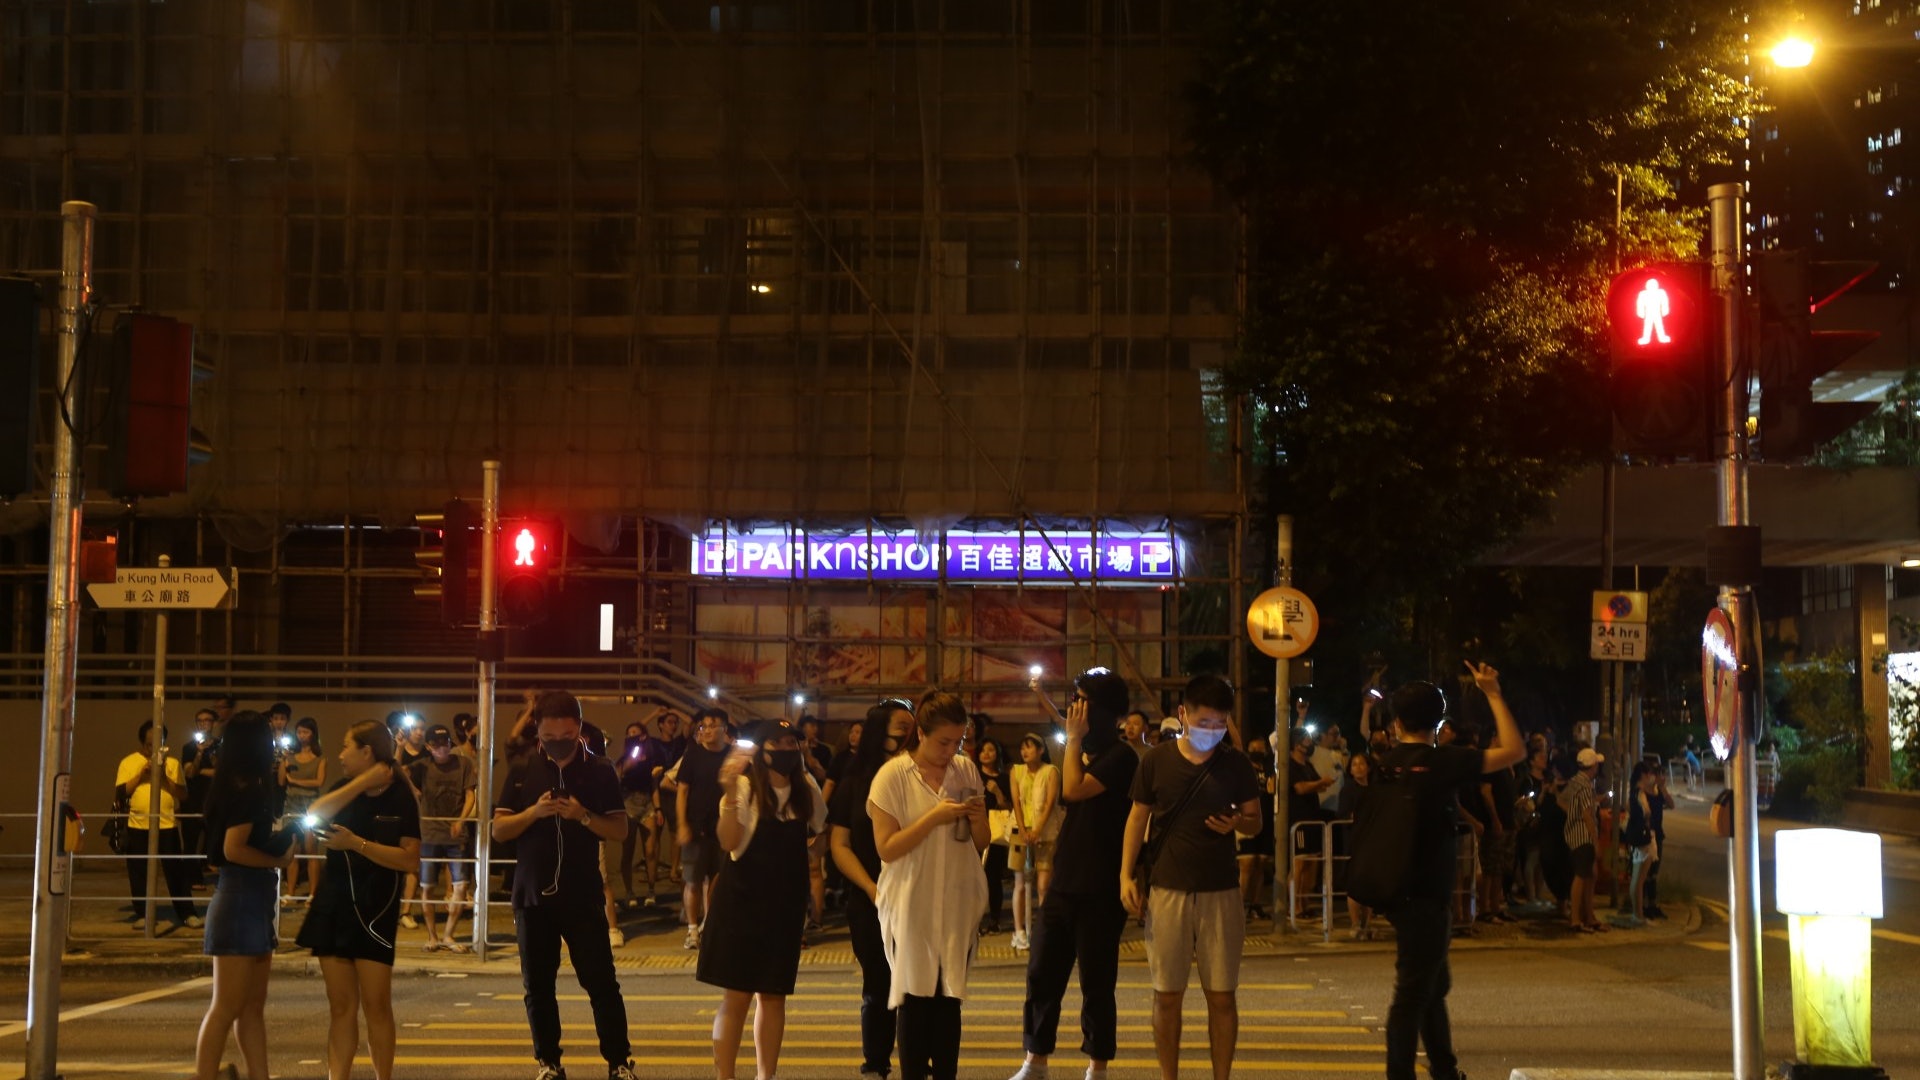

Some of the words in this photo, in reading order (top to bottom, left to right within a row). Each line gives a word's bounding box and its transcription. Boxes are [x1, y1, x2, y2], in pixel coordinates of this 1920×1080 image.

[742, 542, 952, 571] PARKnSHOP
[958, 543, 1134, 572] 百佳超級市場
[127, 573, 157, 584] Kung
[160, 573, 180, 583] Miu
[183, 573, 214, 583] Road
[124, 590, 190, 603] 車公廟路
[1598, 626, 1616, 637] 24
[1620, 627, 1640, 639] hrs
[1601, 641, 1634, 657] 全日
